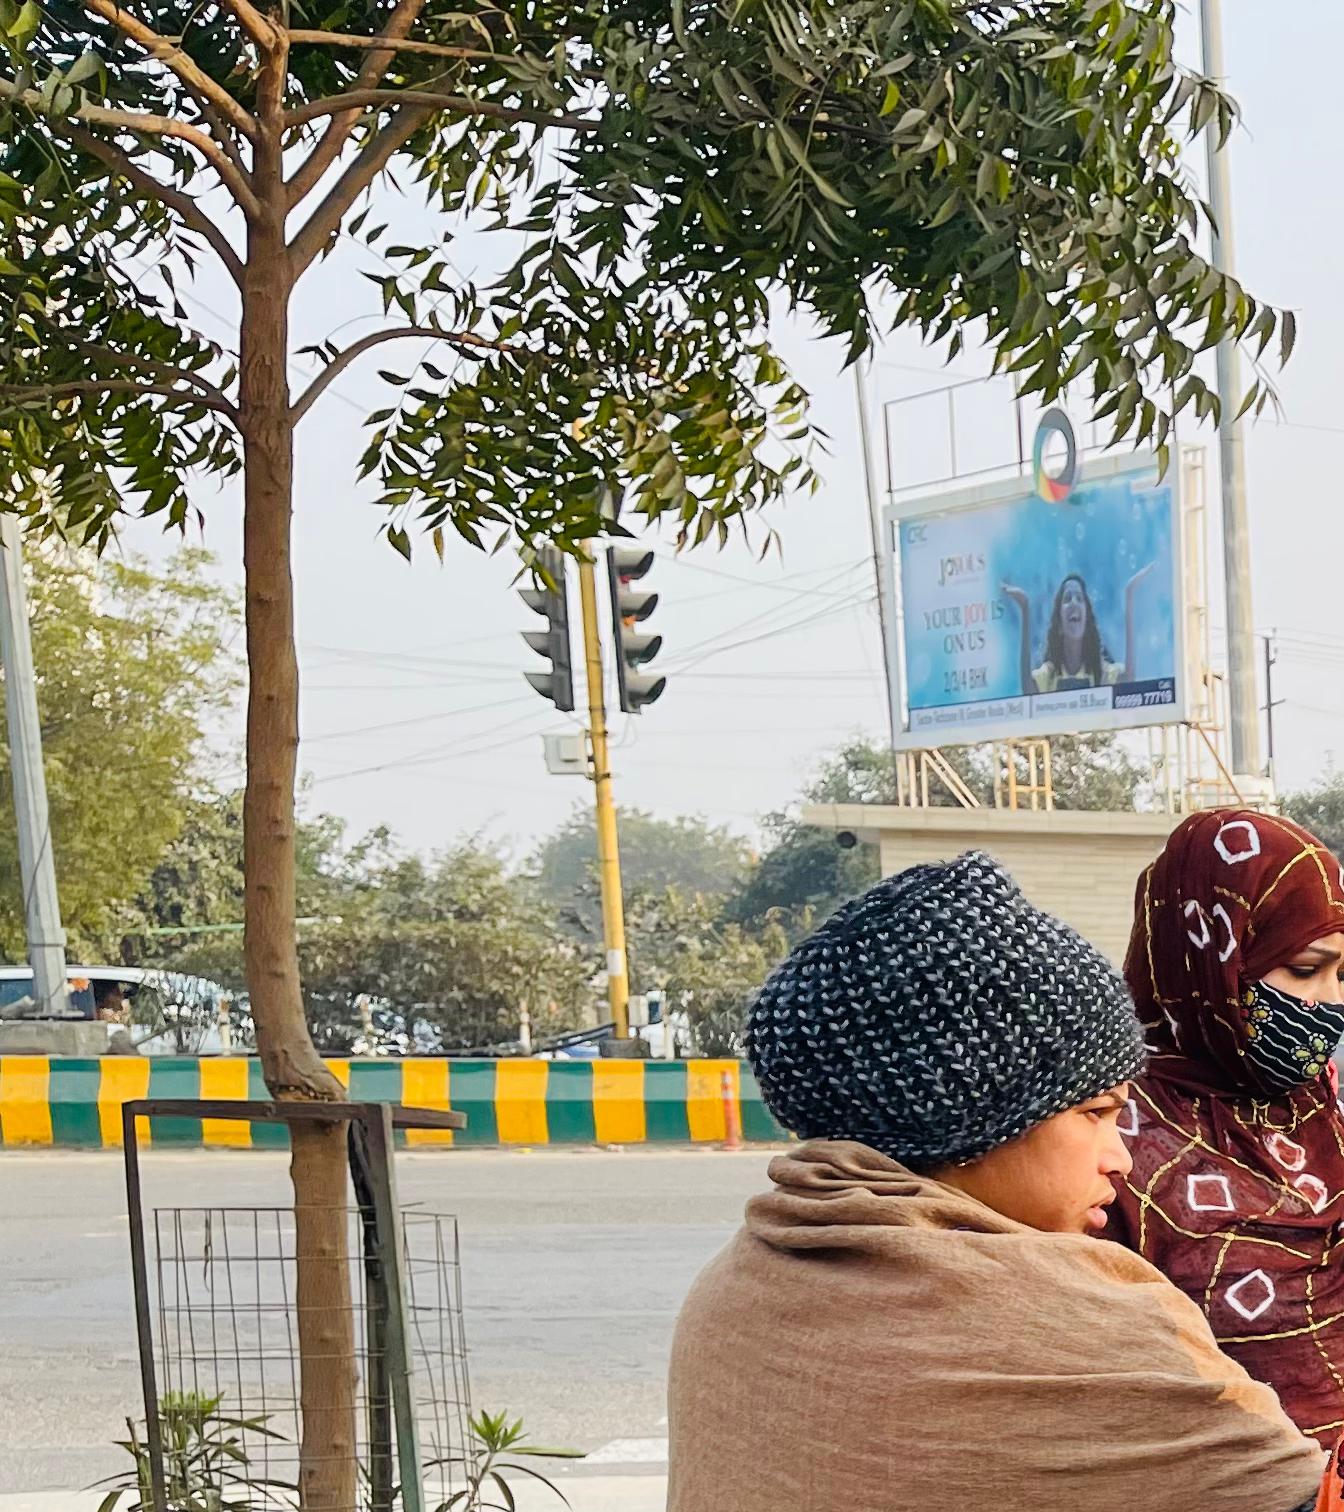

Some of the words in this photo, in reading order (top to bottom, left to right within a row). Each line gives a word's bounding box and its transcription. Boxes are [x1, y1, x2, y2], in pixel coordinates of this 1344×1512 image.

[923, 607, 961, 630] YOUR
[963, 602, 987, 625] JOY
[943, 633, 968, 655] ON
[968, 630, 986, 651] US
